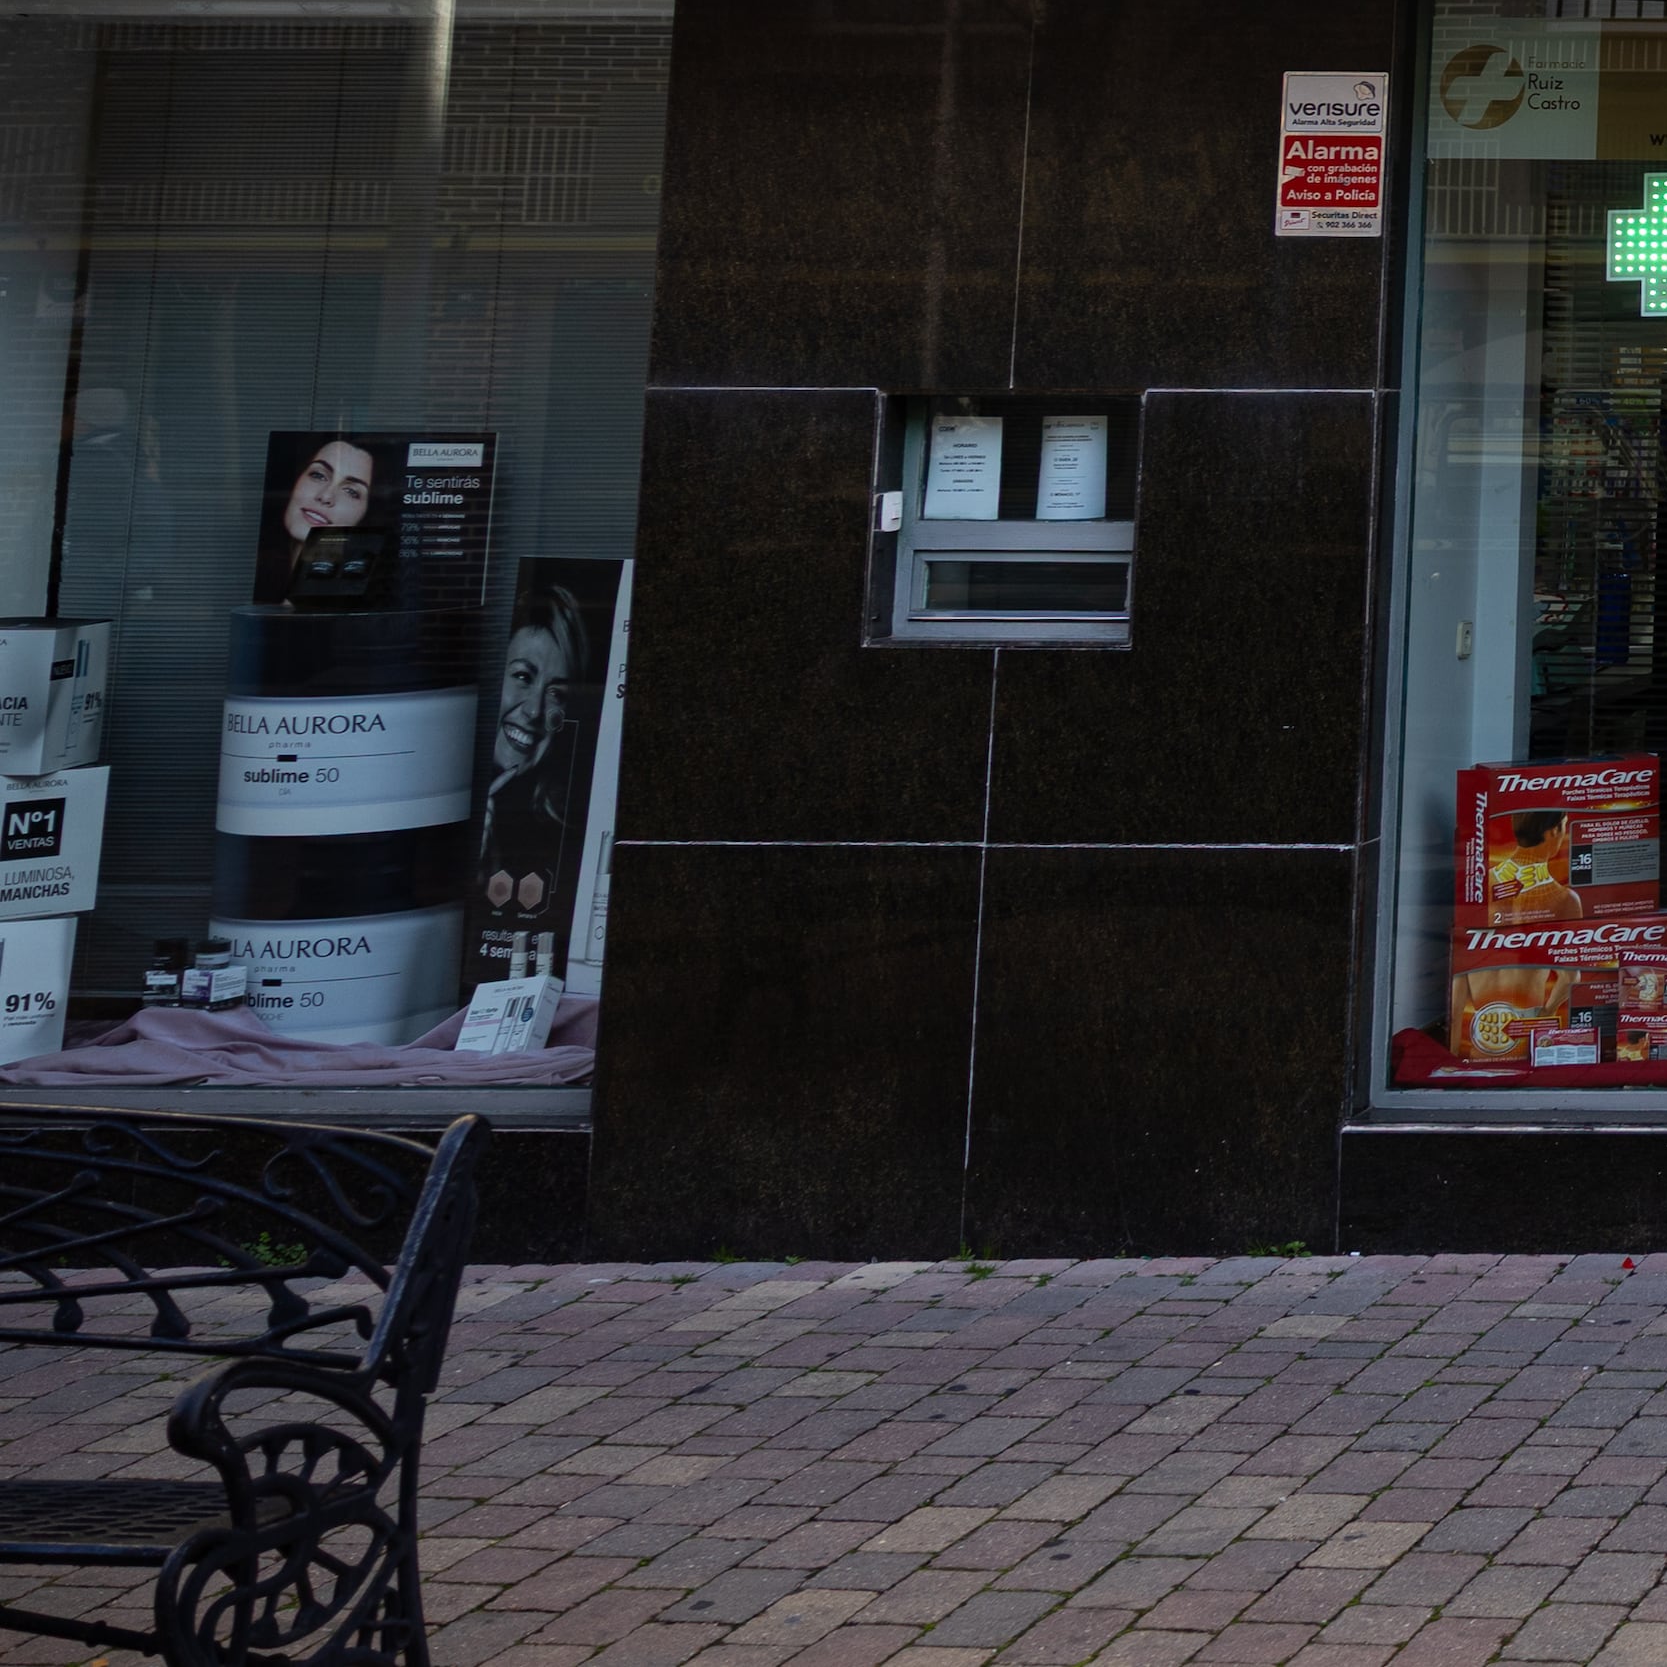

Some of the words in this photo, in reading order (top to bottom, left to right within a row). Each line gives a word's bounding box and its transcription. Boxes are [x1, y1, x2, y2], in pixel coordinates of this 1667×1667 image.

[1528, 73, 1564, 91] Ruiz
[1527, 92, 1581, 111] Castro
[1289, 102, 1381, 117] verisure
[1338, 119, 1376, 127] Seguridad
[1285, 140, 1379, 161] Alarma
[1307, 165, 1325, 173] con
[1328, 164, 1378, 174] grabación
[1306, 174, 1321, 184] de
[1324, 174, 1377, 186] imágenes
[1286, 190, 1321, 201] Aviso
[1324, 192, 1332, 201] a
[1335, 189, 1376, 201] Policía
[1311, 211, 1349, 219] Securitas
[1352, 211, 1378, 219] Direct
[1326, 221, 1340, 229] 902
[413, 448, 439, 457] BELLA
[440, 448, 478, 457] AURORA
[404, 474, 423, 489] Te
[426, 474, 481, 489] sentirás
[402, 491, 464, 505] sublime
[227, 713, 270, 736] BELLA
[275, 713, 387, 735] AURORA
[268, 741, 312, 750] pharma
[243, 768, 310, 784] sublime
[315, 767, 340, 783] 50
[1496, 768, 1655, 793] ThermaCare
[7, 782, 31, 791] BELLA
[32, 779, 68, 789] AURORA
[7, 836, 55, 850] VENTAS
[1474, 791, 1488, 904] ThermaCare
[1578, 853, 1592, 865] 16
[4, 866, 75, 887] LUMINOSA,
[0, 882, 70, 903] MANCHAS
[1494, 912, 1502, 924] 2
[1465, 923, 1667, 950] ThermaCare
[260, 936, 372, 959] AURORA
[480, 942, 489, 957] 4
[1548, 947, 1578, 956] Parches
[1579, 945, 1613, 954] Térmicos
[1554, 955, 1578, 963] Faixas
[1580, 953, 1613, 962] Térmicas
[254, 965, 296, 974] pharma
[5, 991, 56, 1013] 91%
[299, 991, 325, 1008] 50
[1578, 1012, 1592, 1023] 16
